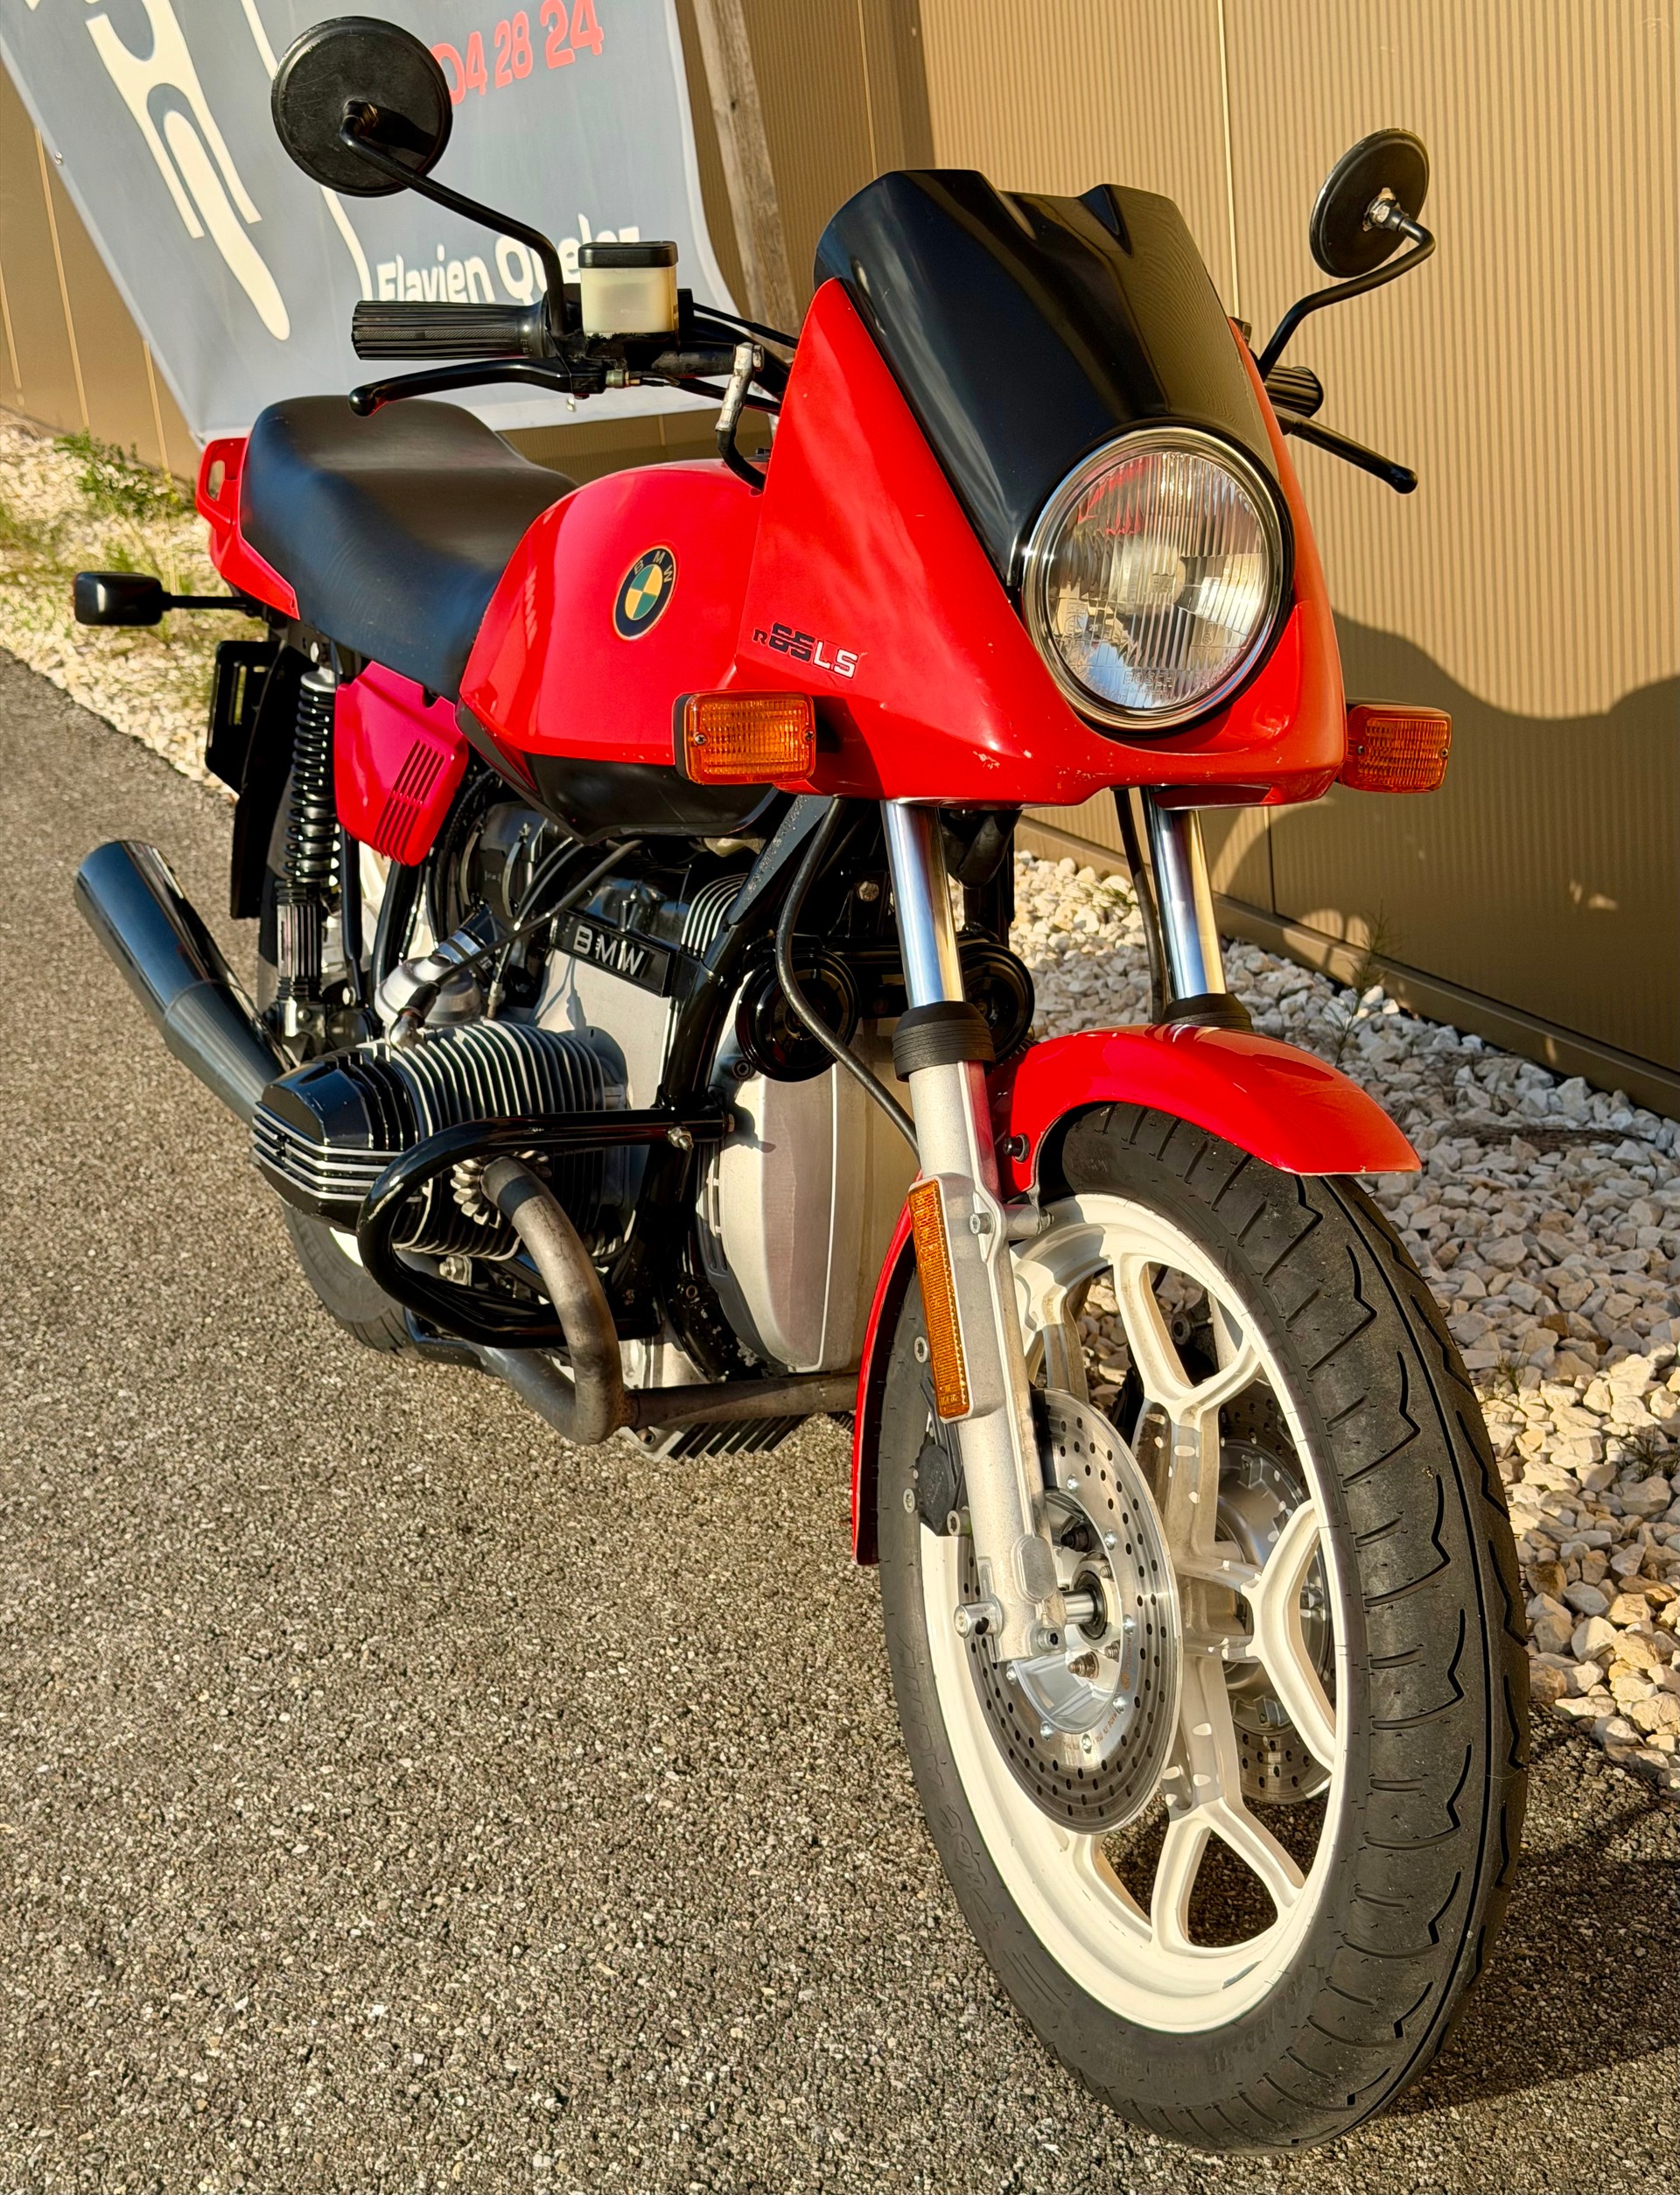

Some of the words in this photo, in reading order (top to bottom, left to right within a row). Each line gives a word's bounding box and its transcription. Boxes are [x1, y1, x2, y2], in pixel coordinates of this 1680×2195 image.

[494, 11, 533, 88] 28
[539, 0, 605, 69] 24
[376, 243, 496, 303] Flavien
[634, 550, 673, 583] BMW
[573, 923, 645, 976] BMW
